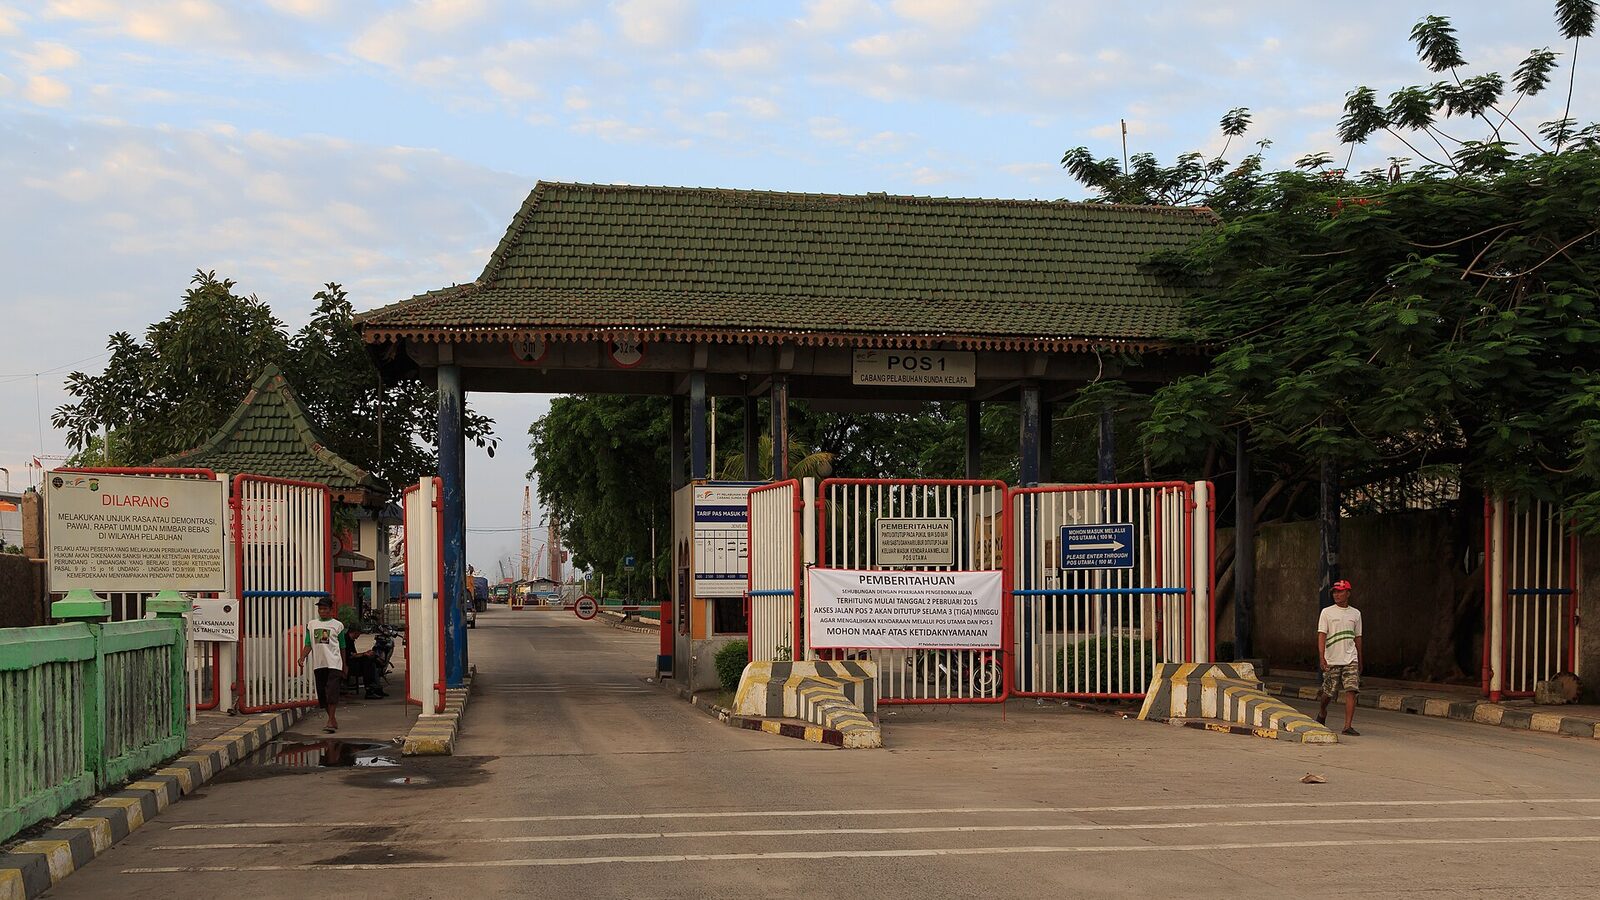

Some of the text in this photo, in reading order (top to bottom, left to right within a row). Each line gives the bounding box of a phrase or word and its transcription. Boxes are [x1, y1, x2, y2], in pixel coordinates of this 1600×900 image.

[887, 355, 946, 371] POS 1
[860, 374, 968, 384] CABANG PELABUHAN SUNDA KELAPA
[102, 494, 169, 508] DILARANG
[58, 513, 104, 521] MELAKUKAN
[106, 514, 131, 522] UNJUK
[132, 515, 151, 523] RASA
[152, 516, 170, 524] ATAU
[66, 522, 92, 530] PAWAI,
[119, 524, 142, 532] UMUM
[141, 533, 183, 541] PELABUHAN
[859, 575, 955, 585] PEMBERITAHUAN
[953, 608, 972, 616] (TIGA)
[826, 627, 860, 635] MOHON
[862, 628, 887, 636] MAAF
[887, 628, 908, 636] ATAS
